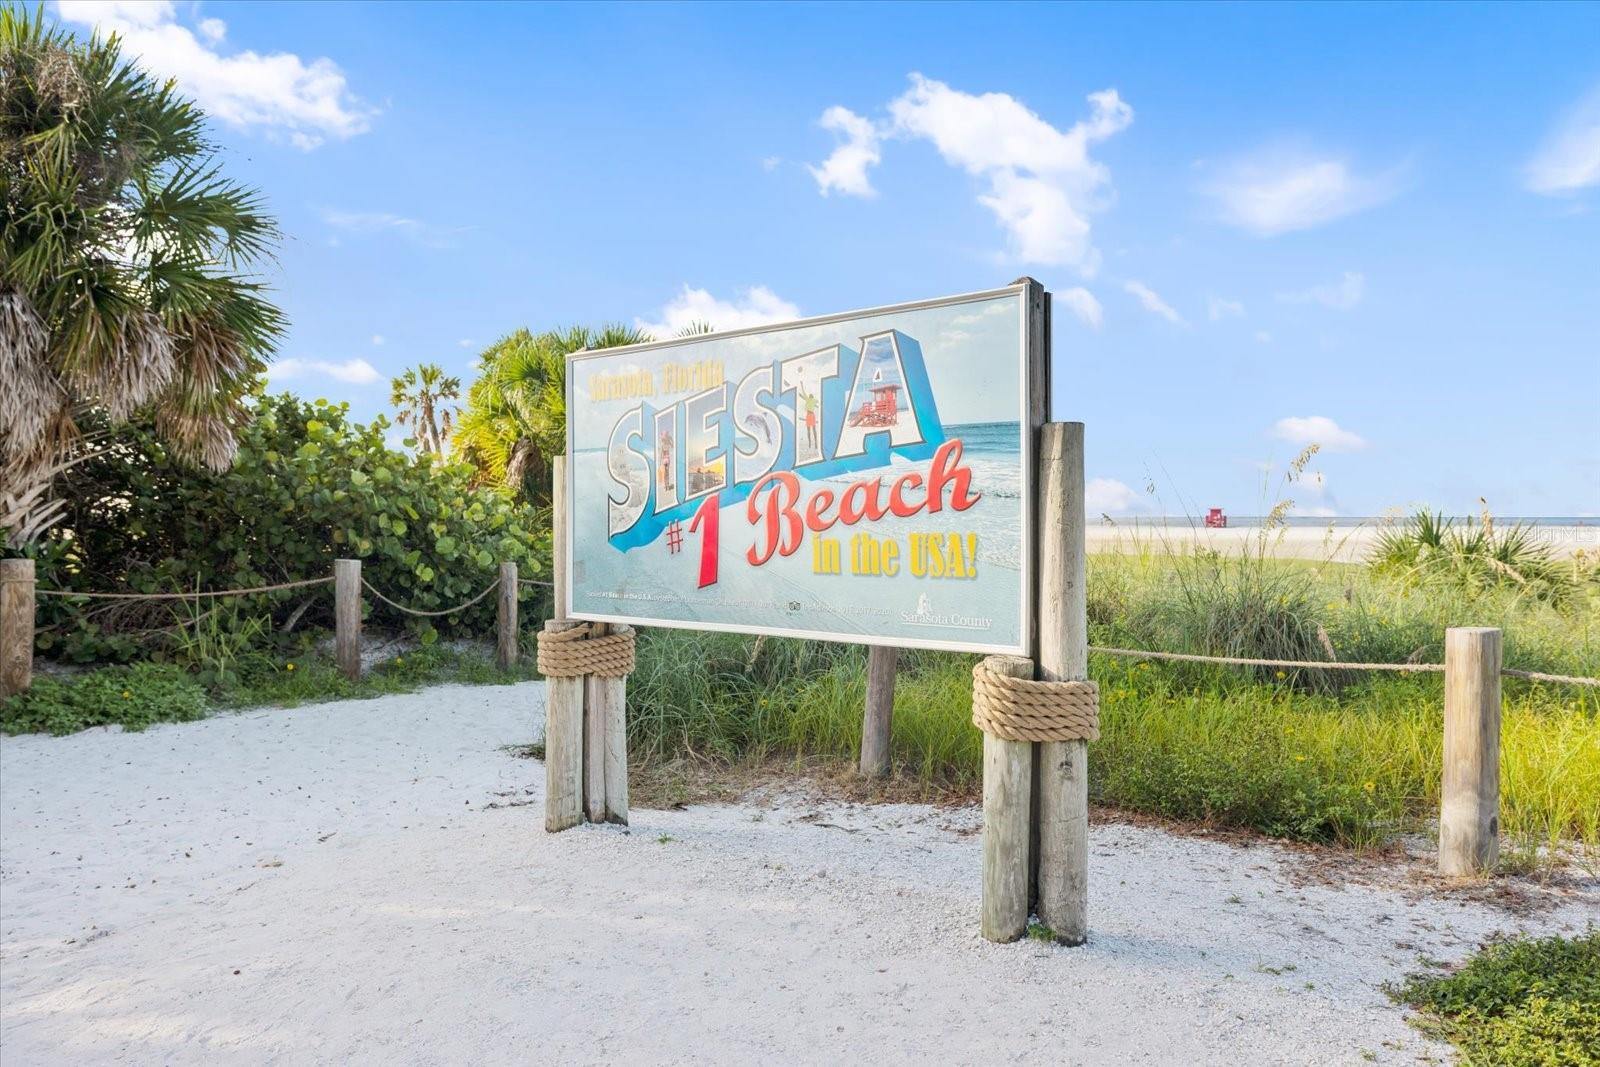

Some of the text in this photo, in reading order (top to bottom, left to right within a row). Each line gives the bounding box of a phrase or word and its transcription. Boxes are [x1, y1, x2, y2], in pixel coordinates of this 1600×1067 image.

[607, 328, 929, 543] SIESTA
[665, 438, 981, 589] #1 Beach
[811, 531, 978, 579] in the USA!
[900, 609, 993, 628] Sarasota County
